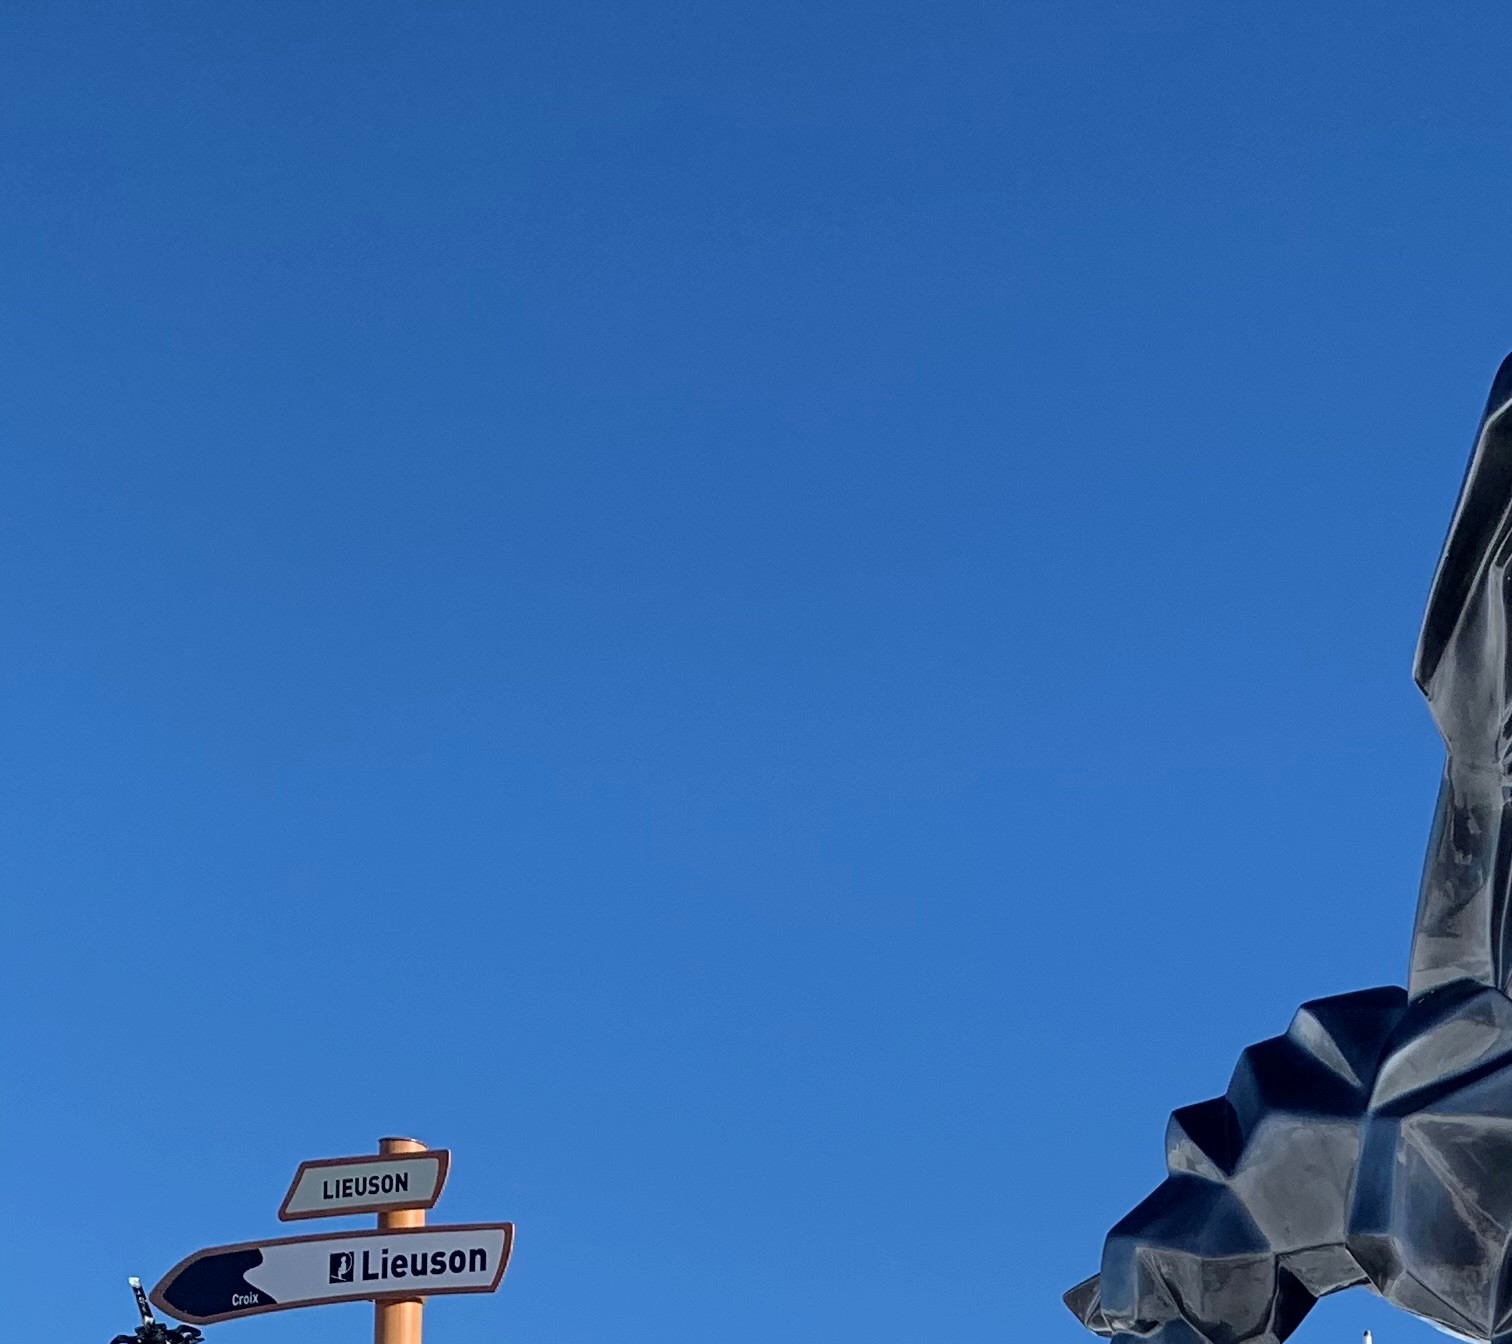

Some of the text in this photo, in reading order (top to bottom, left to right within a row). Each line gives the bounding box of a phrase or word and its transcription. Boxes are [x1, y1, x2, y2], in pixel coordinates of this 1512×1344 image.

[323, 1172, 409, 1199] LIEUSON
[362, 1247, 487, 1281] Lieuson
[231, 1291, 259, 1306] Croix
